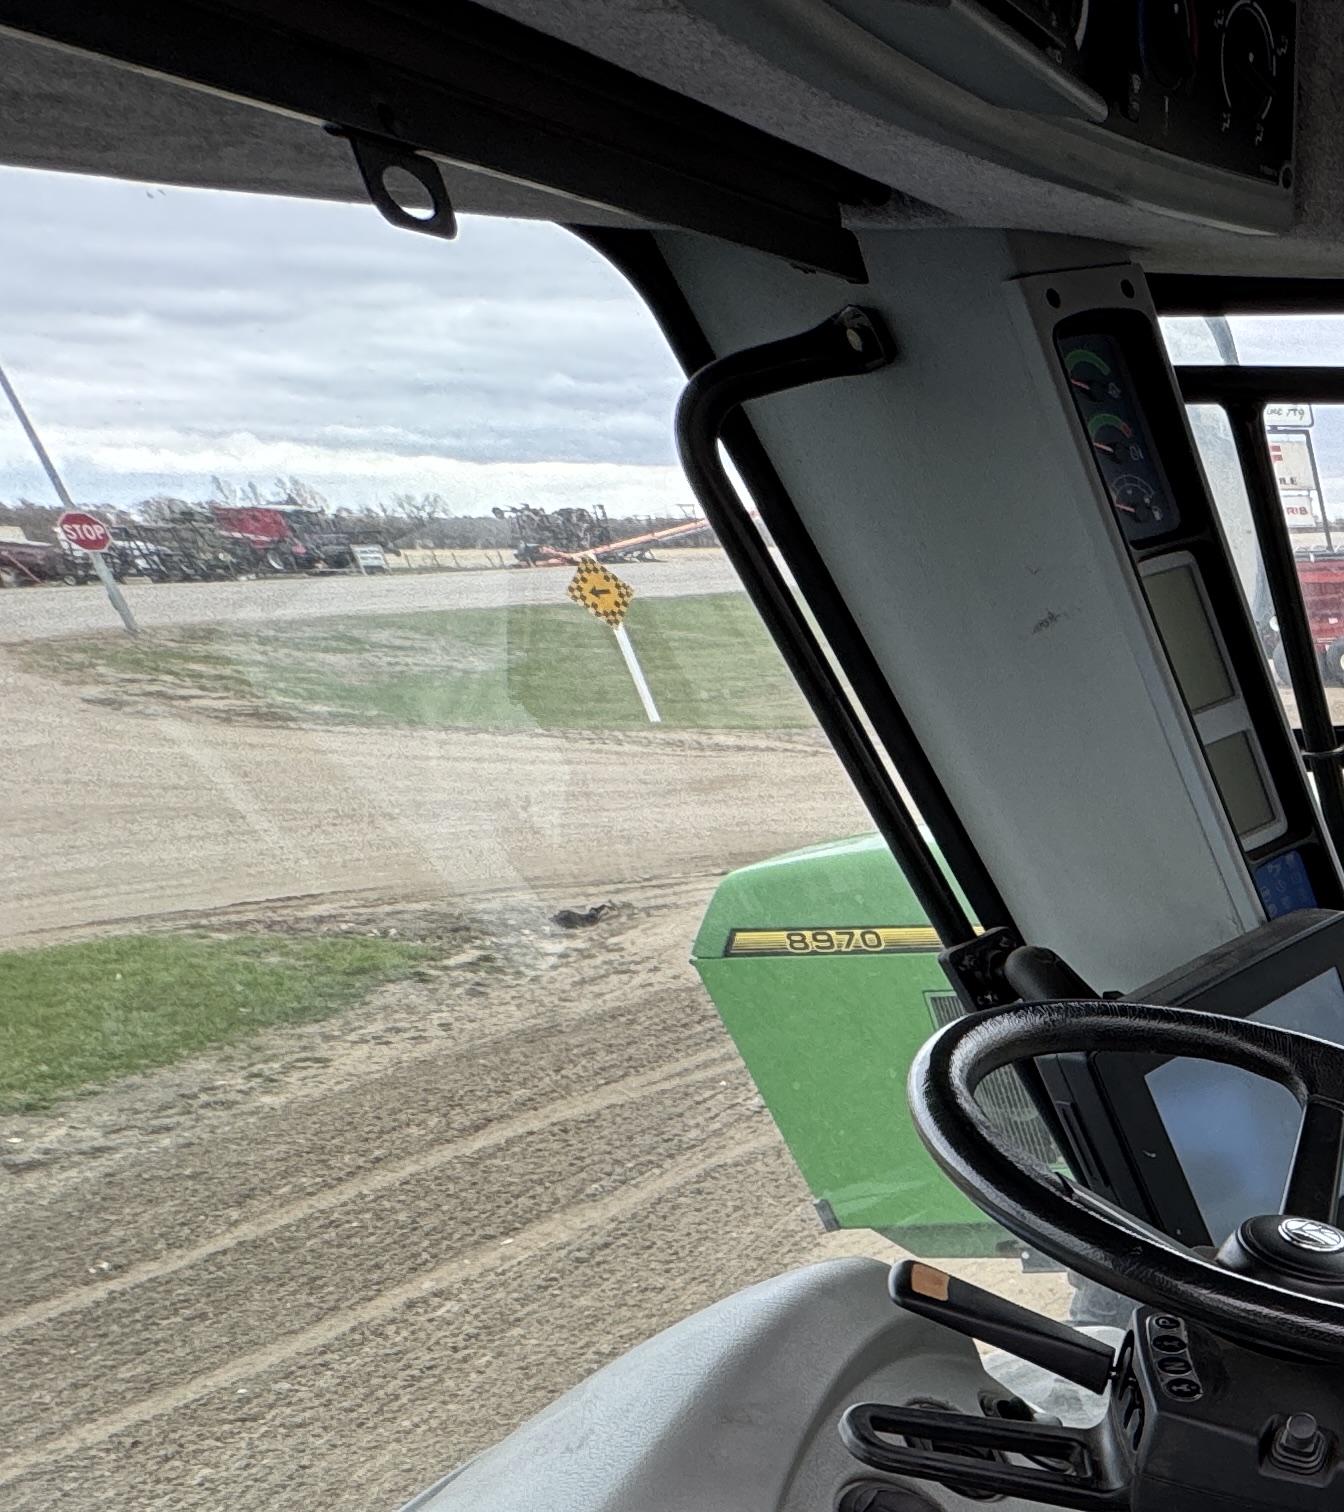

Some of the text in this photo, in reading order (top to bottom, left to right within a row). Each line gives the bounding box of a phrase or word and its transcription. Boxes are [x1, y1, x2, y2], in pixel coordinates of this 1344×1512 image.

[1286, 507, 1308, 515] RIB
[63, 524, 104, 541] STOP
[785, 929, 885, 953] 8970
